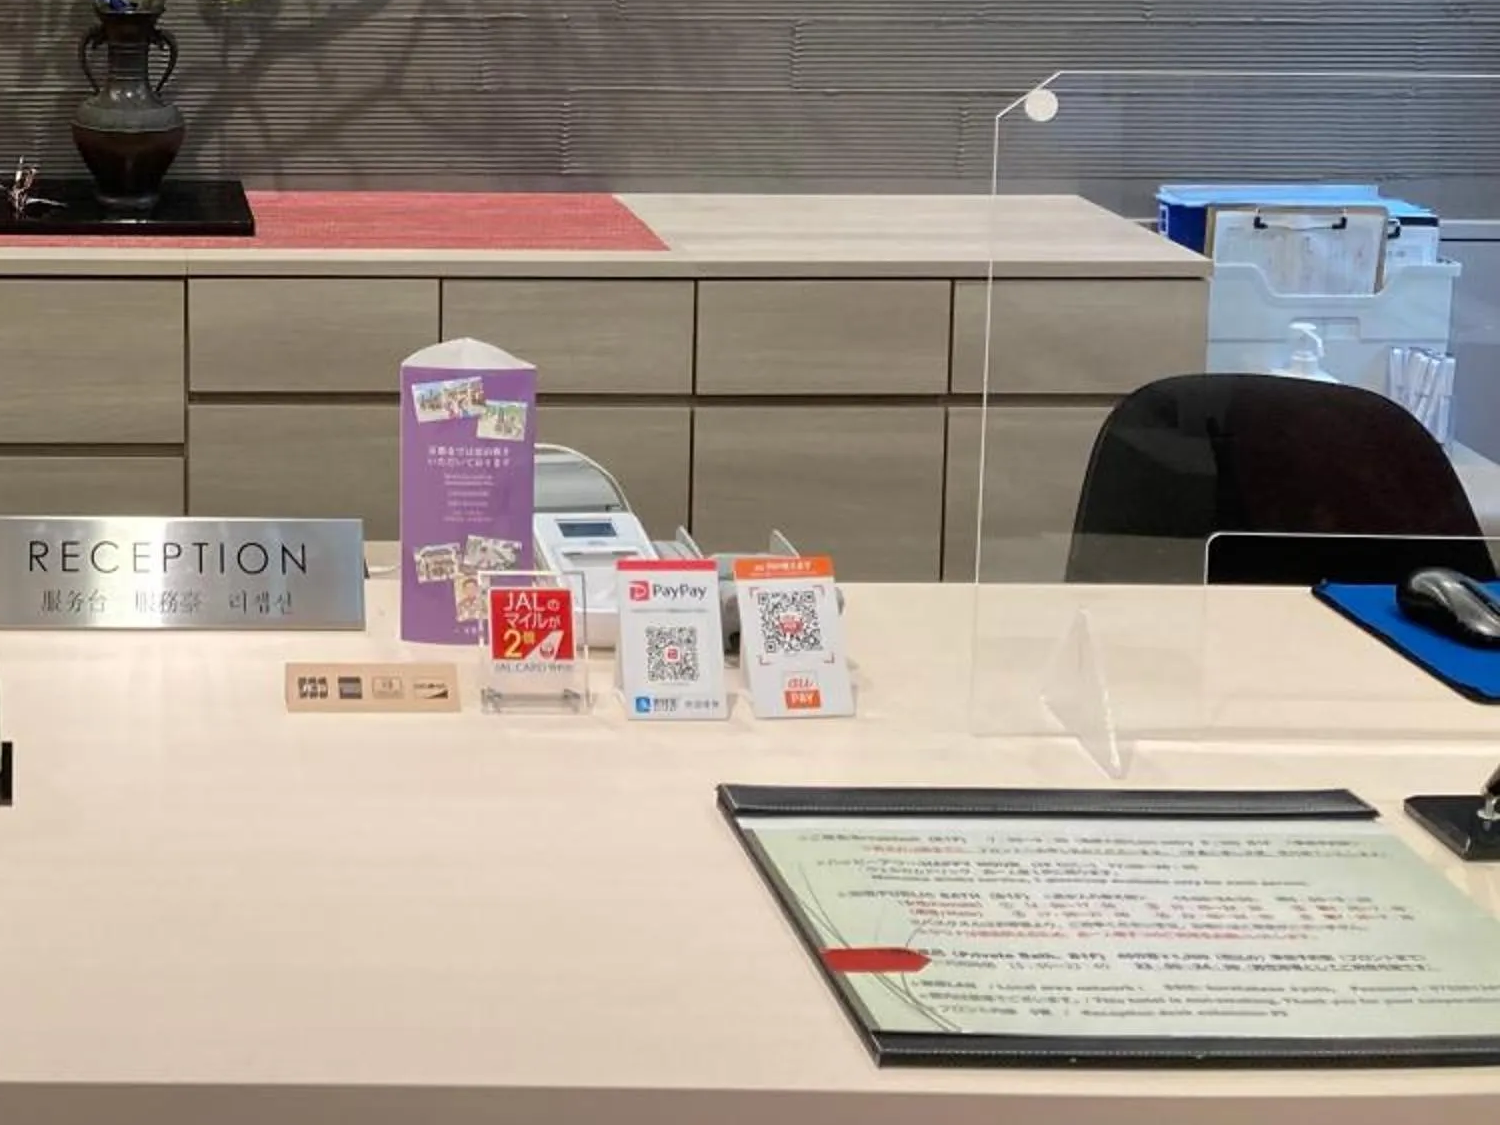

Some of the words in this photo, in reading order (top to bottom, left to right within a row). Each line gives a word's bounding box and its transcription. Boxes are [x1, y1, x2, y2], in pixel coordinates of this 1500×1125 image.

[27, 540, 308, 575] RECEPTION
[40, 588, 107, 614] 服务台
[653, 583, 707, 601] PayPay
[503, 612, 561, 629] マイルが
